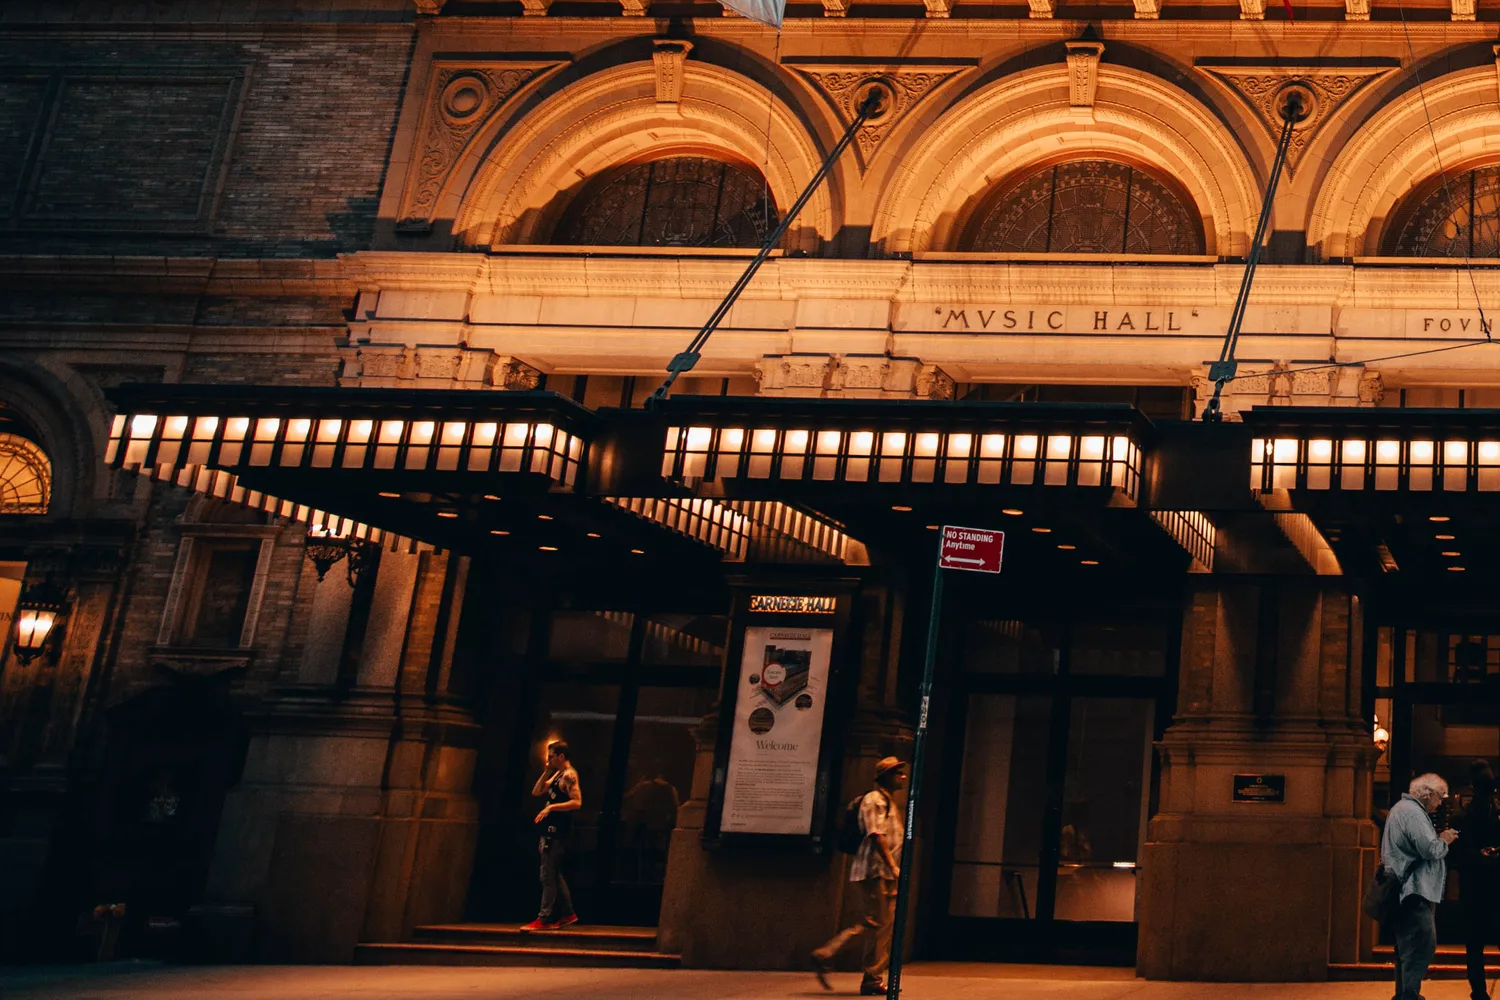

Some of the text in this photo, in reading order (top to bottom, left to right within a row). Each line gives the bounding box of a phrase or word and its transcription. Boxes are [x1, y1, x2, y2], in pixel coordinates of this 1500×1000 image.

[945, 530, 994, 543] NO STANDING
[945, 540, 976, 550] Anytime
[807, 596, 835, 612] HALL
[756, 740, 799, 751] Welcome
